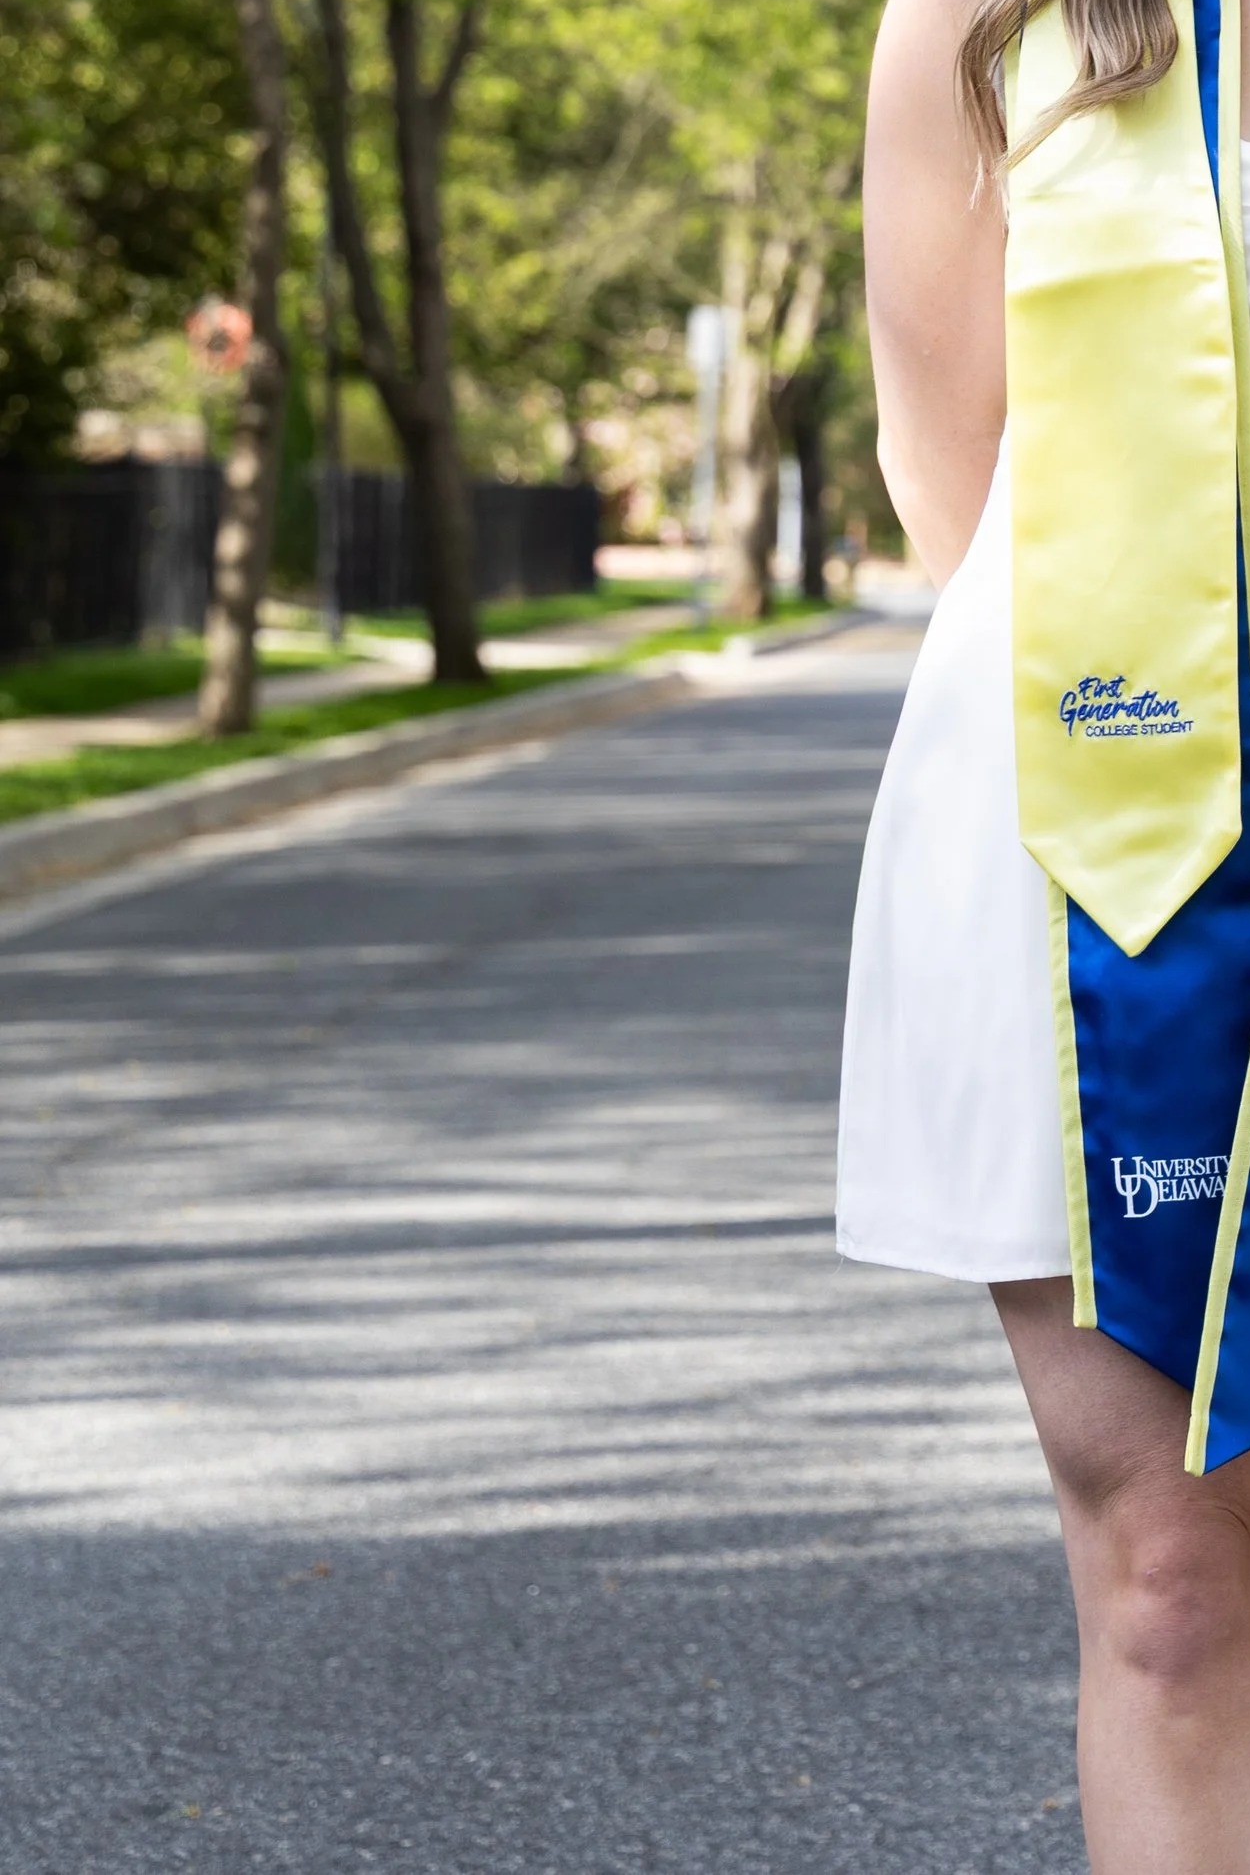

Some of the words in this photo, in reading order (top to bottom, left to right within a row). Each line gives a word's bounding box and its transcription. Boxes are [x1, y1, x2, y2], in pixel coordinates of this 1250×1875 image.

[1078, 675, 1125, 700] First
[1060, 690, 1179, 736] Generation
[1085, 724, 1138, 737] COLLEGE
[1140, 720, 1194, 735] STUDENT
